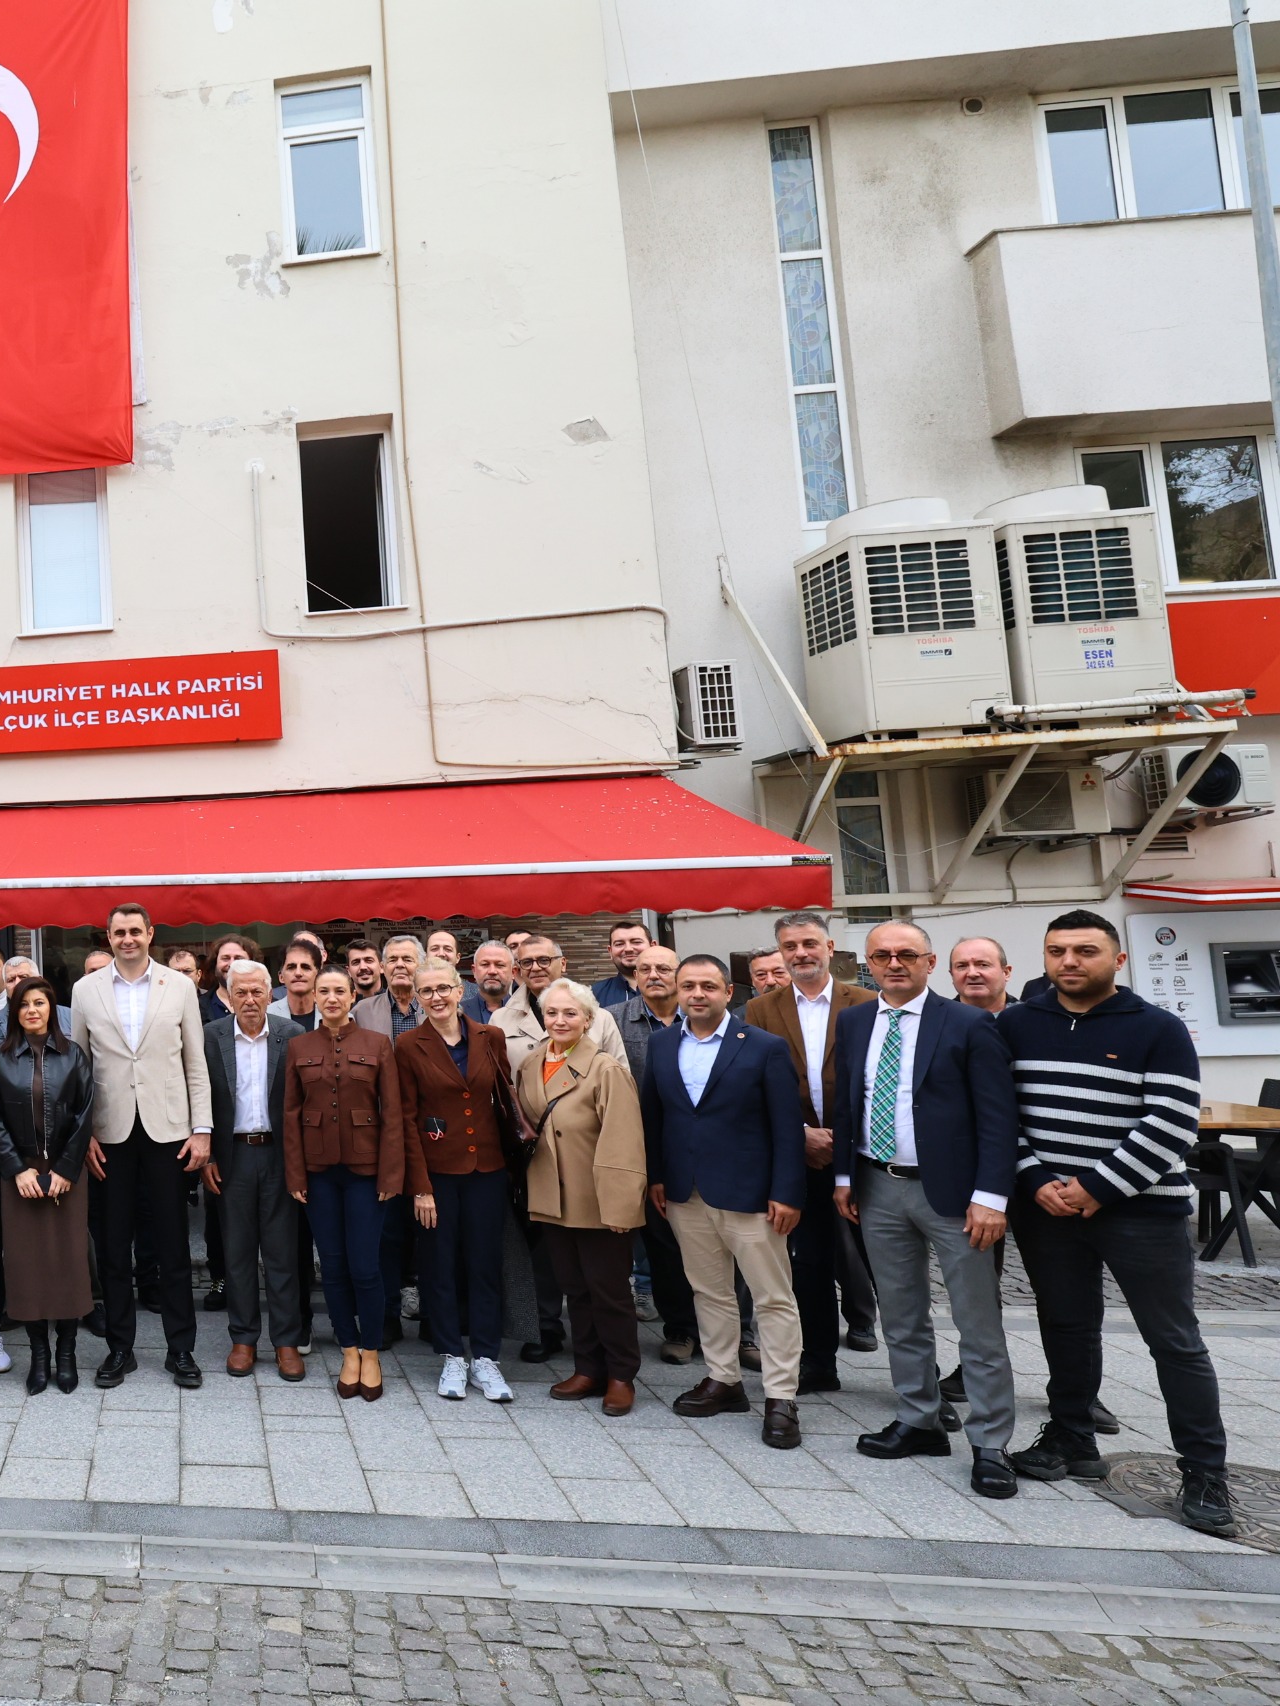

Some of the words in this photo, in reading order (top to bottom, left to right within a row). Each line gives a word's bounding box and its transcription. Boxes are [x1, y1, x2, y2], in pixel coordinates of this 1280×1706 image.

[1077, 625, 1116, 634] TOSHIBA
[916, 636, 955, 645] TOSHIBA
[1084, 649, 1113, 660] ESEN
[111, 681, 171, 699] HALK
[176, 671, 263, 695] PARTİSİ
[53, 710, 100, 728] İLÇE
[105, 698, 241, 725] BAŞKANLIĞI
